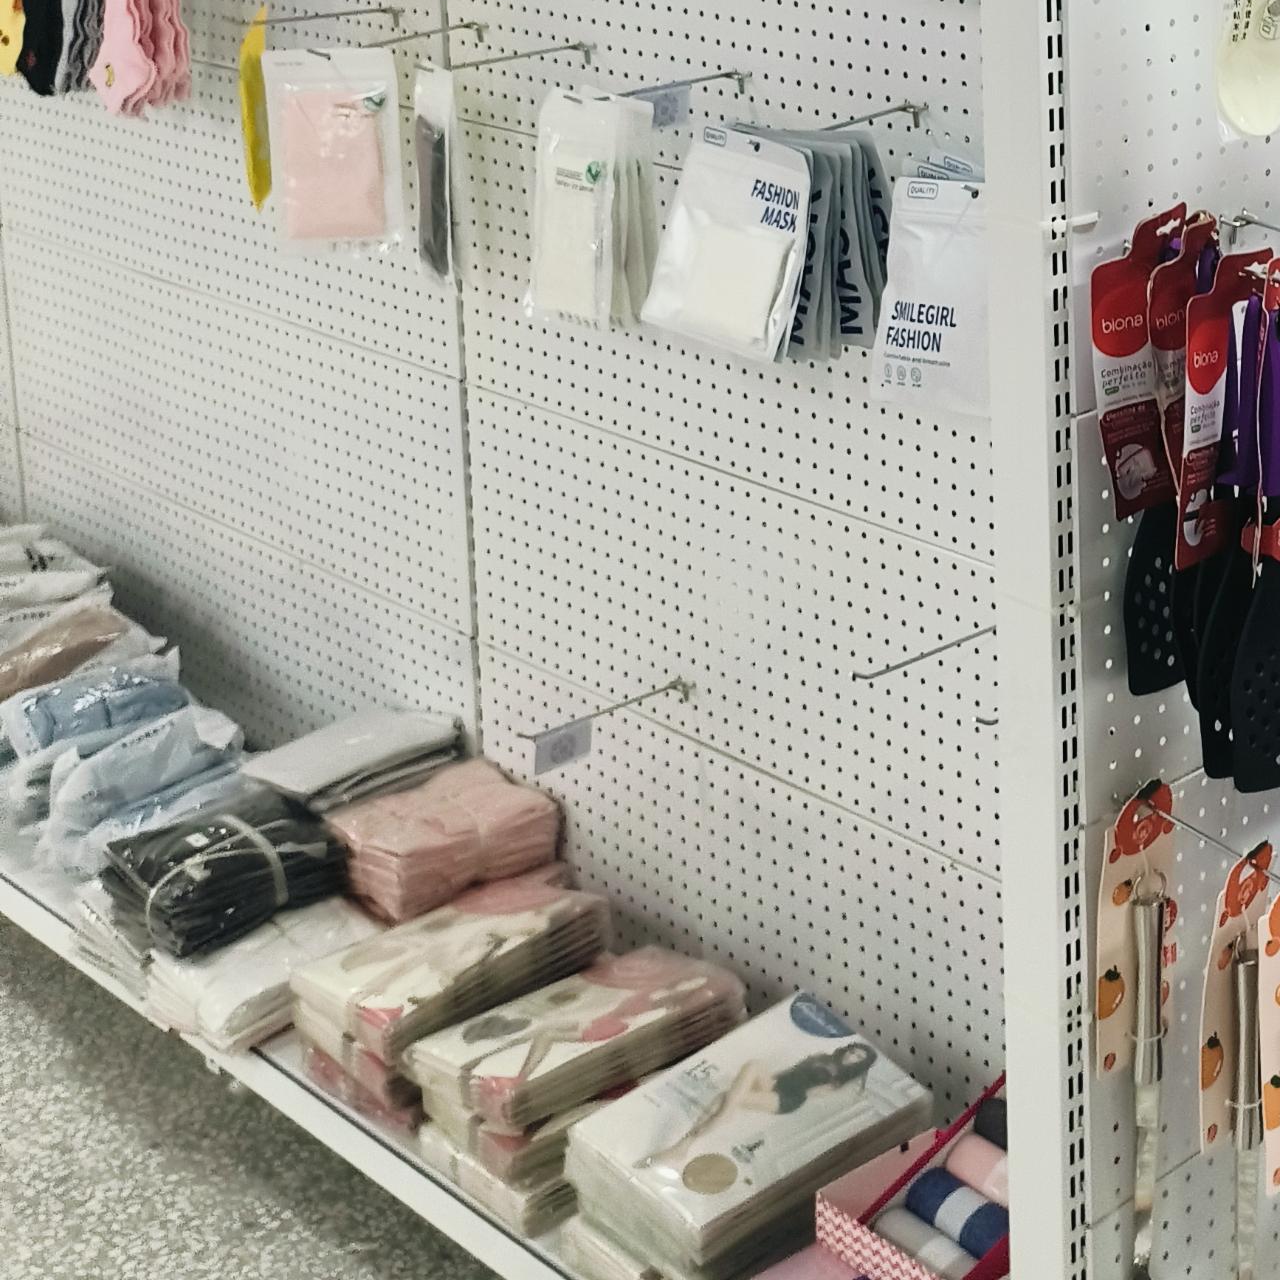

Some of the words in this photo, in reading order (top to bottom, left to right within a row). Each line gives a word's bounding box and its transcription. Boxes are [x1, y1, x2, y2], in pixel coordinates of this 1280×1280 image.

[751, 178, 800, 211] FASHION
[910, 185, 936, 195] QUALITY
[760, 205, 797, 233] MASK
[891, 300, 957, 328] SMILEGIRL
[1155, 308, 1185, 330] bion
[885, 325, 942, 353] FASHION
